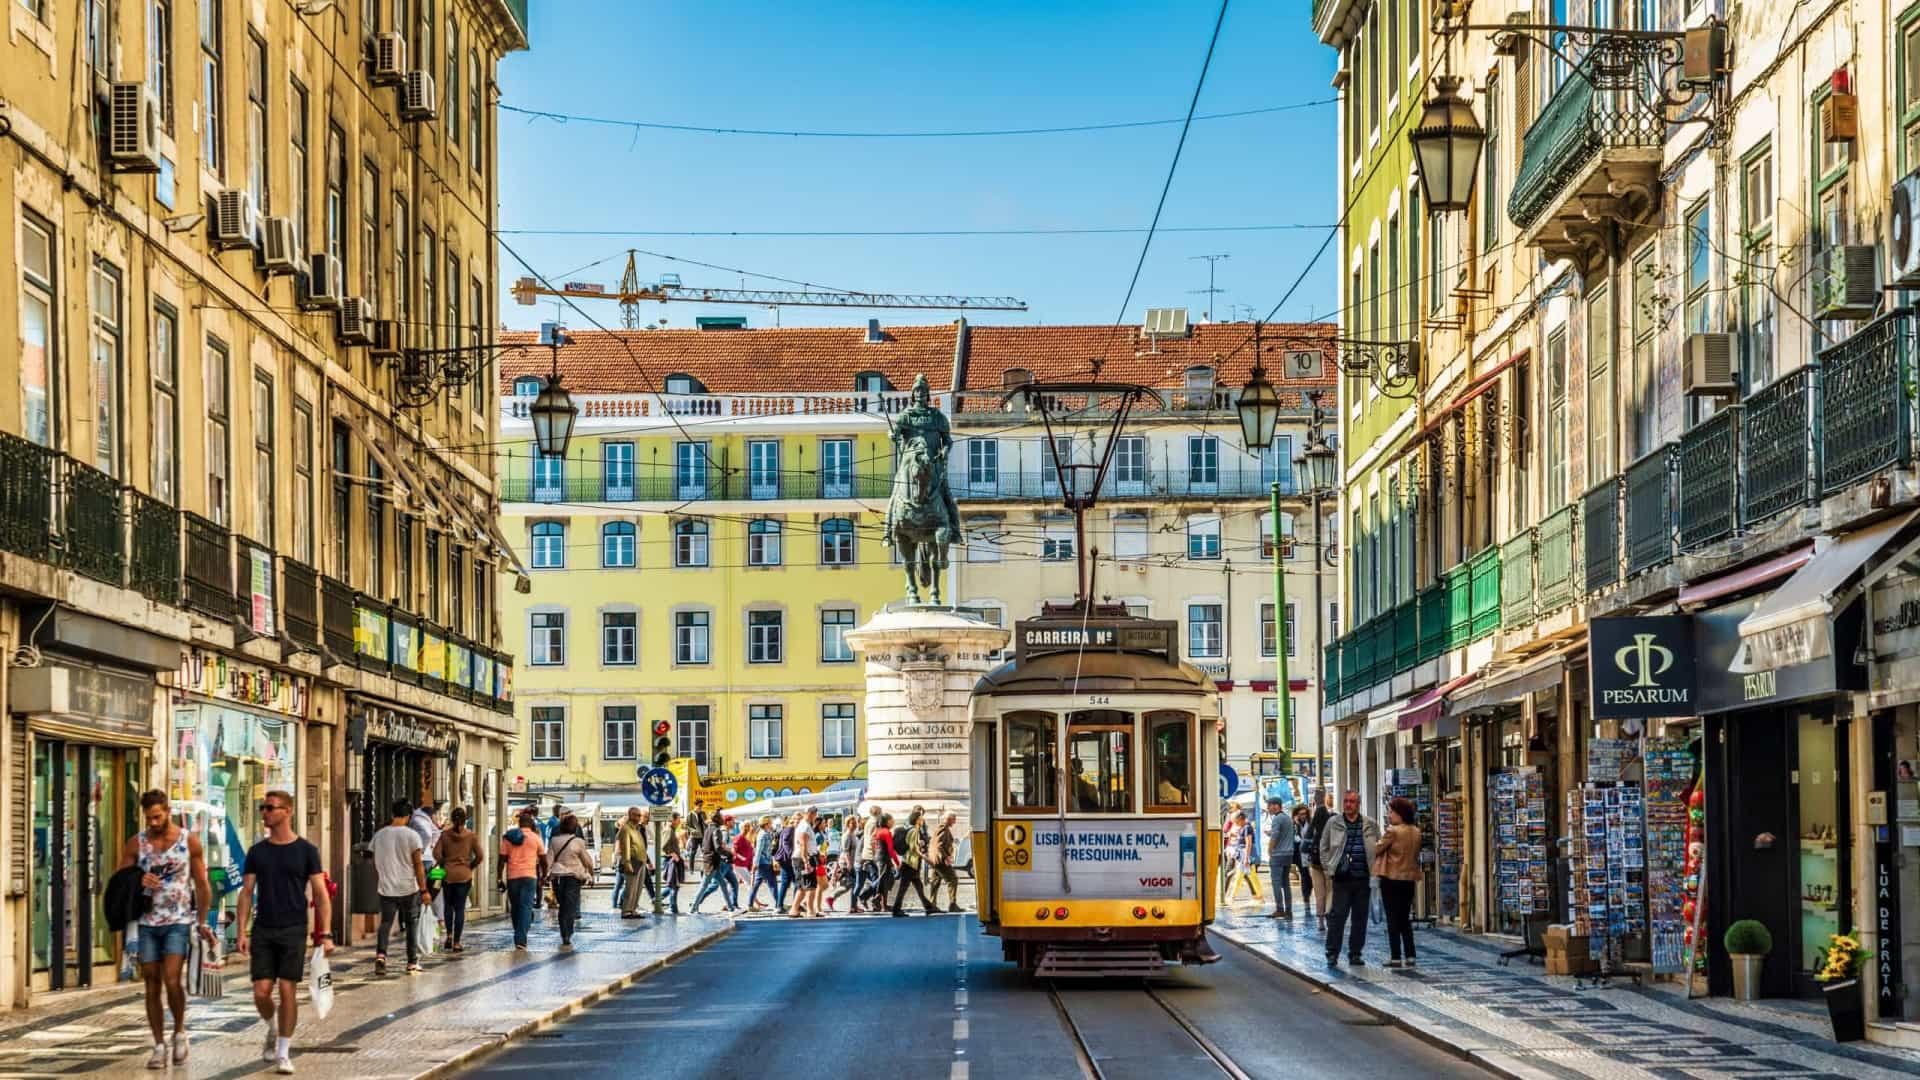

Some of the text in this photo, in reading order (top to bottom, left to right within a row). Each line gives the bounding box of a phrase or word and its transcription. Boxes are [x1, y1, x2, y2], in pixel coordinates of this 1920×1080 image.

[1293, 352, 1312, 370] 10
[1025, 629, 1113, 645] CARREIRA Nº
[1743, 670, 1777, 701] PESARUM
[1089, 696, 1110, 706] 544
[1603, 688, 1689, 704] PESARUM
[887, 727, 893, 736] A
[897, 726, 920, 736] DOM
[926, 723, 955, 735] JOÃO
[887, 741, 963, 751] A CIDADE DE LISBOA
[1035, 833, 1169, 849] LISBOA MENINA E MOÇA,
[1064, 848, 1142, 862] FRESQUINHA.
[1139, 877, 1174, 888] VIGOR
[1879, 863, 1892, 997] LUA DE PRATA
